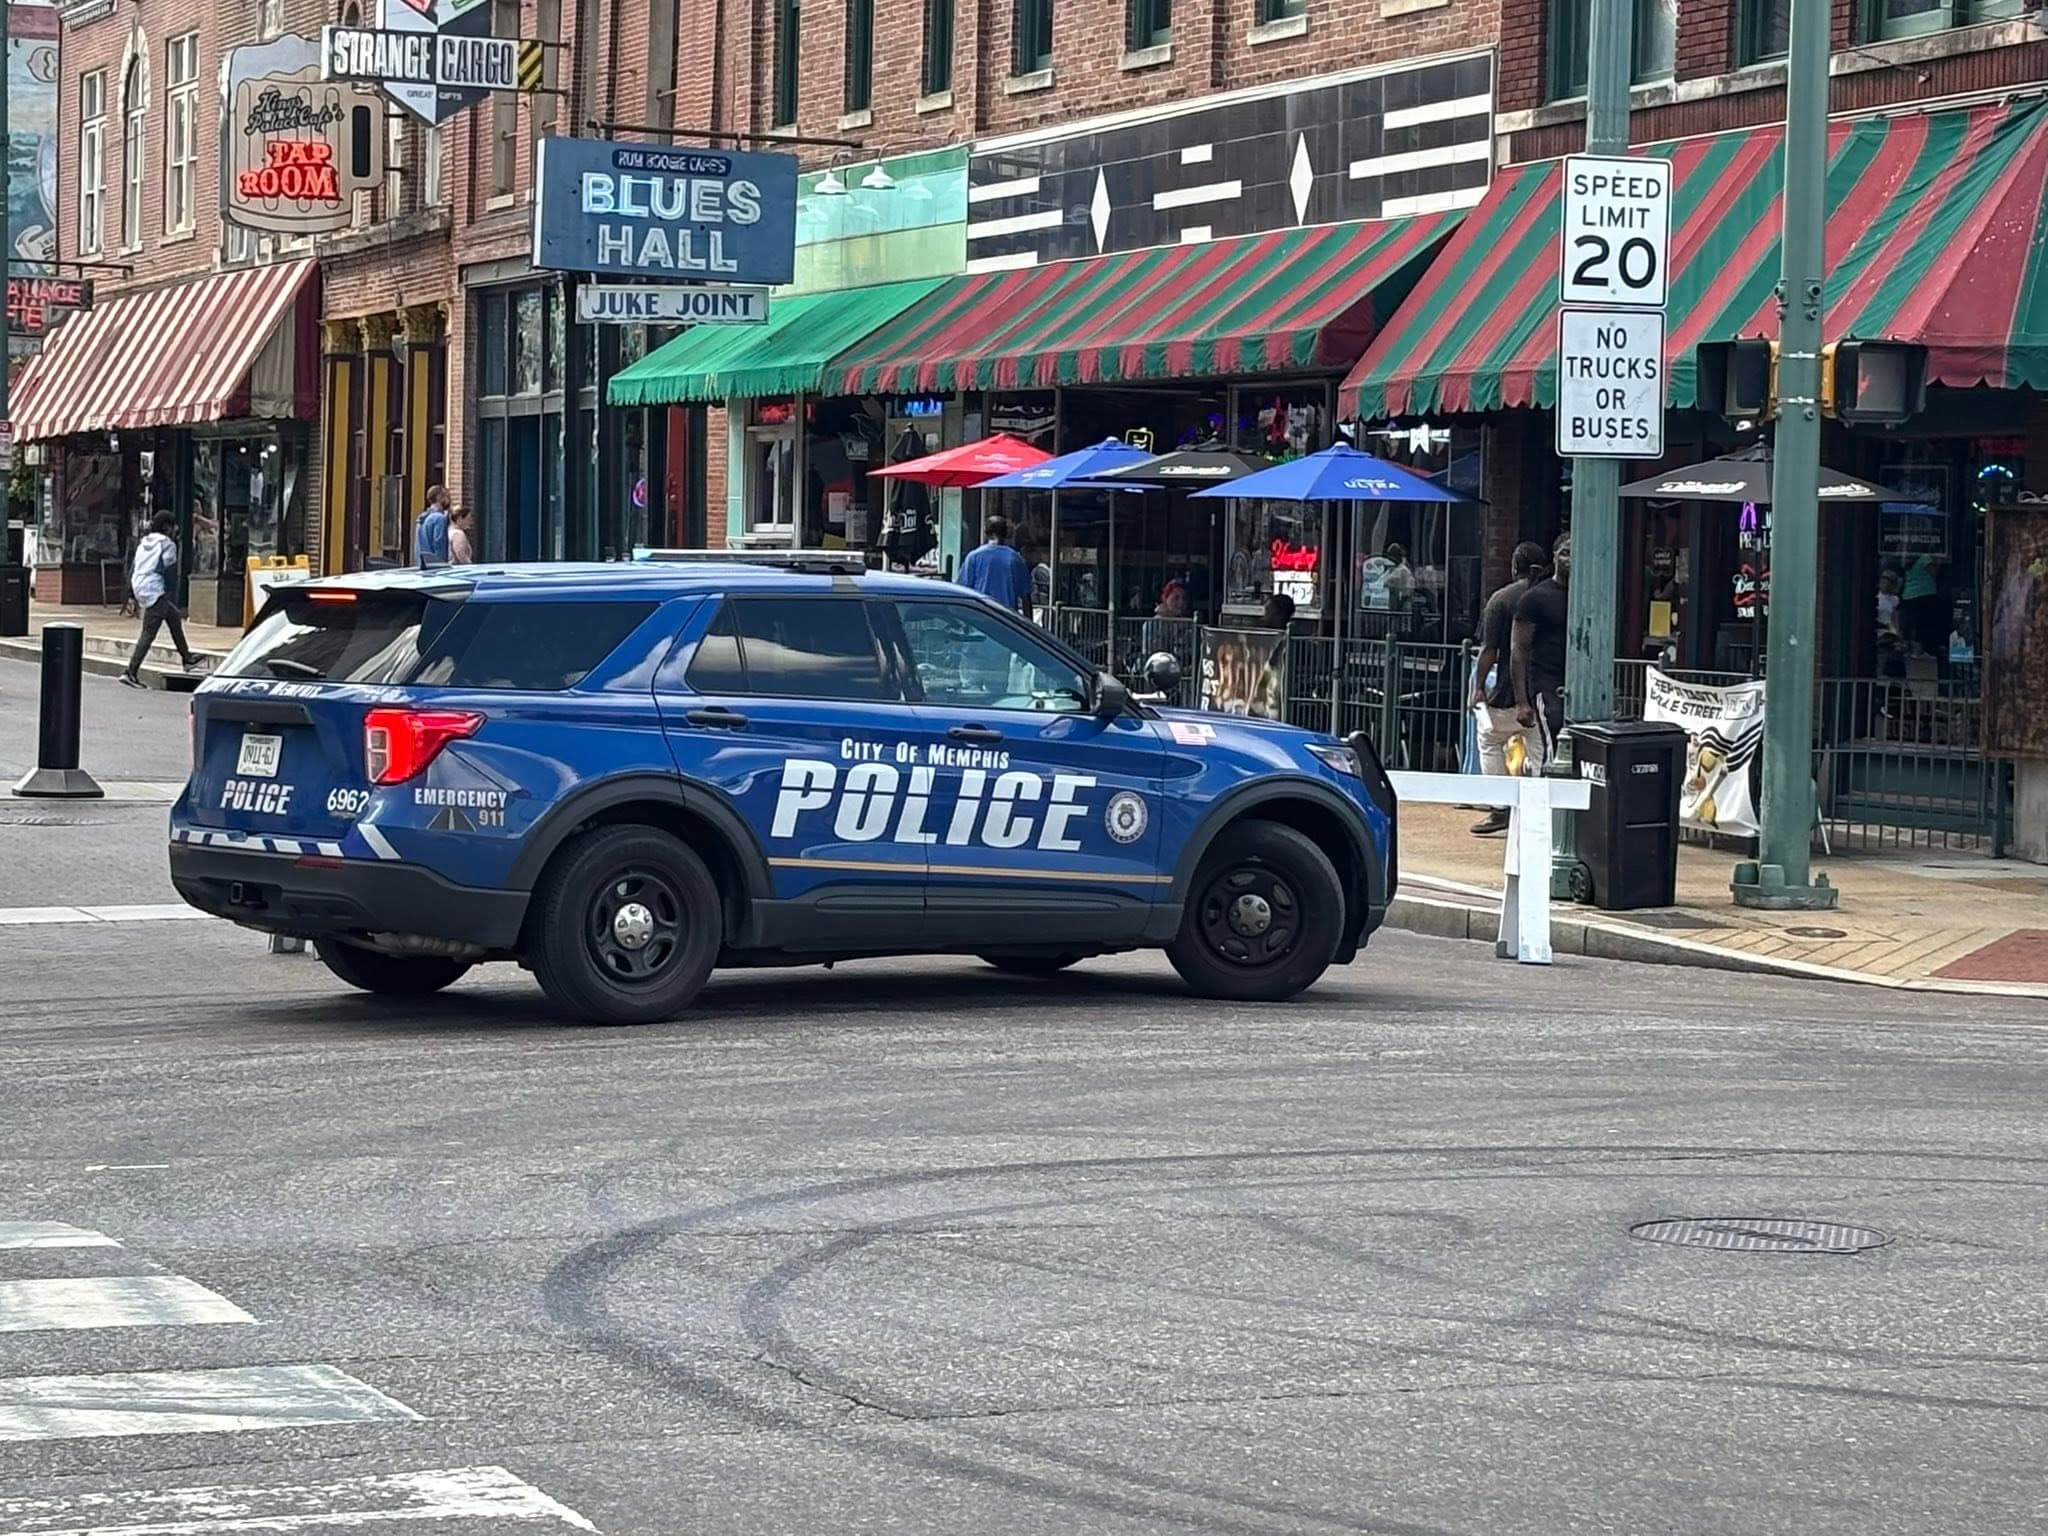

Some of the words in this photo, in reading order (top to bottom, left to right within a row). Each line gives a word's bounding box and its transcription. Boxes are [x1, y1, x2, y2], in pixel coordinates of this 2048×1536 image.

[334, 31, 431, 80] STRANGE
[442, 39, 514, 85] CARGO
[268, 141, 332, 166] TAP
[240, 166, 337, 197] ROOM
[1573, 174, 1662, 199] SPEED
[582, 172, 762, 225] BLUES
[1582, 205, 1651, 229] LIMIT
[597, 224, 738, 273] HALL
[1572, 234, 1657, 289] 20
[592, 292, 660, 316] JUKE
[675, 294, 755, 316] JOINT
[1596, 327, 1627, 349] NO
[1566, 356, 1658, 380] TRUCKS
[1596, 388, 1626, 410] OR
[1572, 417, 1649, 440] BUSES
[1343, 479, 1401, 489] ULTRA
[841, 738, 883, 761] CITY
[896, 742, 918, 765] OF
[928, 744, 1010, 769] MEMPHIS
[220, 780, 294, 815] POLICE
[415, 788, 507, 808] EMERGENCY
[770, 759, 1097, 850] POLICE
[478, 810, 505, 826] 911
